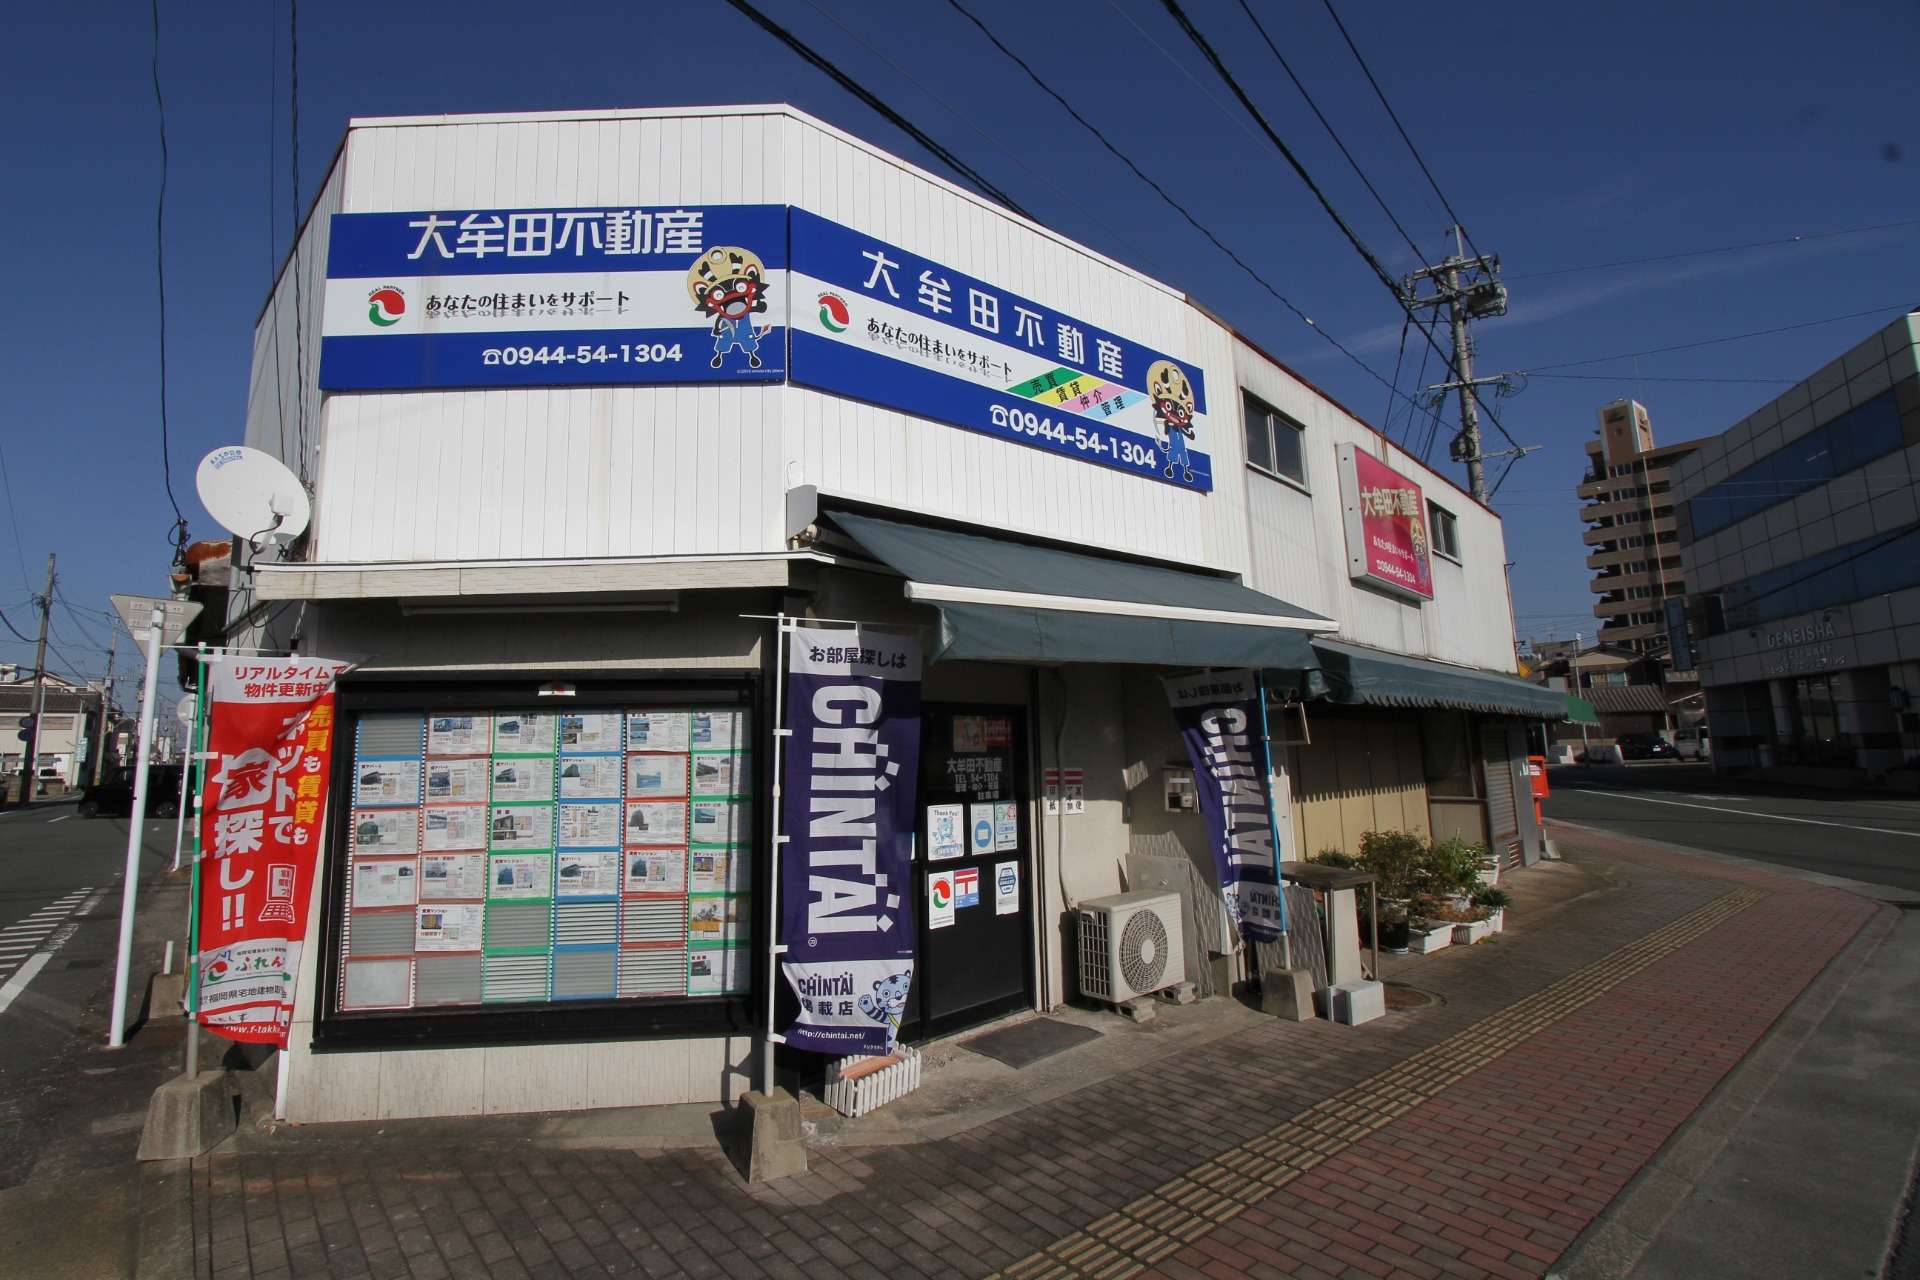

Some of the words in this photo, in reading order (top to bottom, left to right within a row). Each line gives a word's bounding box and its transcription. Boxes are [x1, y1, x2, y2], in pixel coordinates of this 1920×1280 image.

[407, 209, 703, 260] 大牟田不動産
[425, 290, 631, 312] あなたの住まいをサポート
[862, 249, 1124, 379] 大牟田不動産
[502, 344, 683, 367] 0944-54-1304
[867, 317, 1013, 376] あなたの住まいをサポート
[1030, 372, 1058, 394] 売買
[1055, 380, 1083, 402] 賃貸
[1079, 389, 1104, 411] 仲介
[1009, 408, 1157, 470] 0944-54-1304
[809, 646, 907, 669] お部屋探しは
[244, 682, 328, 698] 物件更新中
[946, 757, 1003, 774] 大牟田不動産
